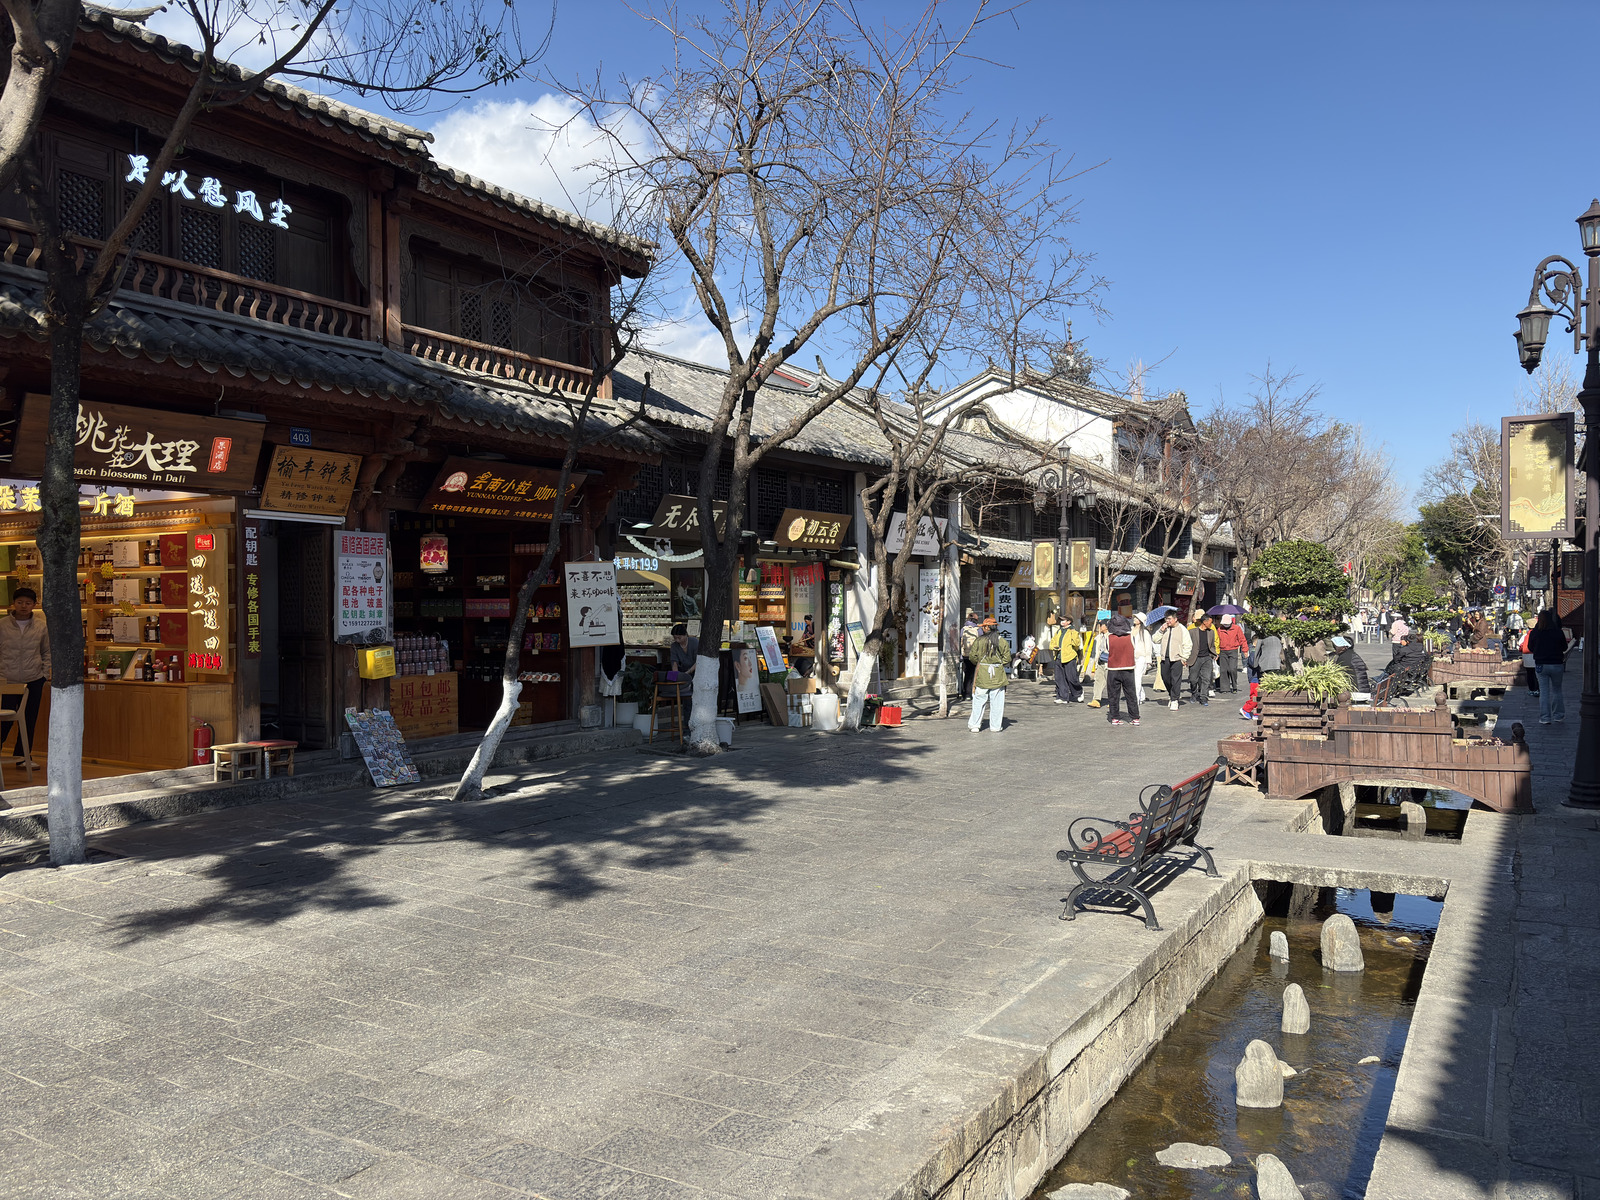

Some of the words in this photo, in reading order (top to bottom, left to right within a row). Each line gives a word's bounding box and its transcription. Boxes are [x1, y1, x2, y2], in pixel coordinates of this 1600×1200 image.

[125, 153, 293, 229] 足以慰风尘
[292, 432, 310, 443] 403
[73, 467, 97, 476] each
[100, 468, 148, 480] blossoms
[152, 473, 162, 481] in
[165, 473, 186, 483] Dali
[277, 456, 352, 485] 榆丰钟表
[466, 491, 496, 500] YUNNAN
[496, 494, 523, 502] COFFEE
[806, 519, 841, 538] 初云谷
[245, 526, 258, 566] 配钥匙
[342, 585, 384, 597] 配各种电子
[246, 573, 261, 653] 专修各国手表
[342, 598, 359, 609] 电池
[998, 584, 1012, 624] 免费试吃
[342, 609, 366, 619] 配钥匙
[368, 609, 384, 619] 刻章
[390, 679, 451, 699] 国包邮
